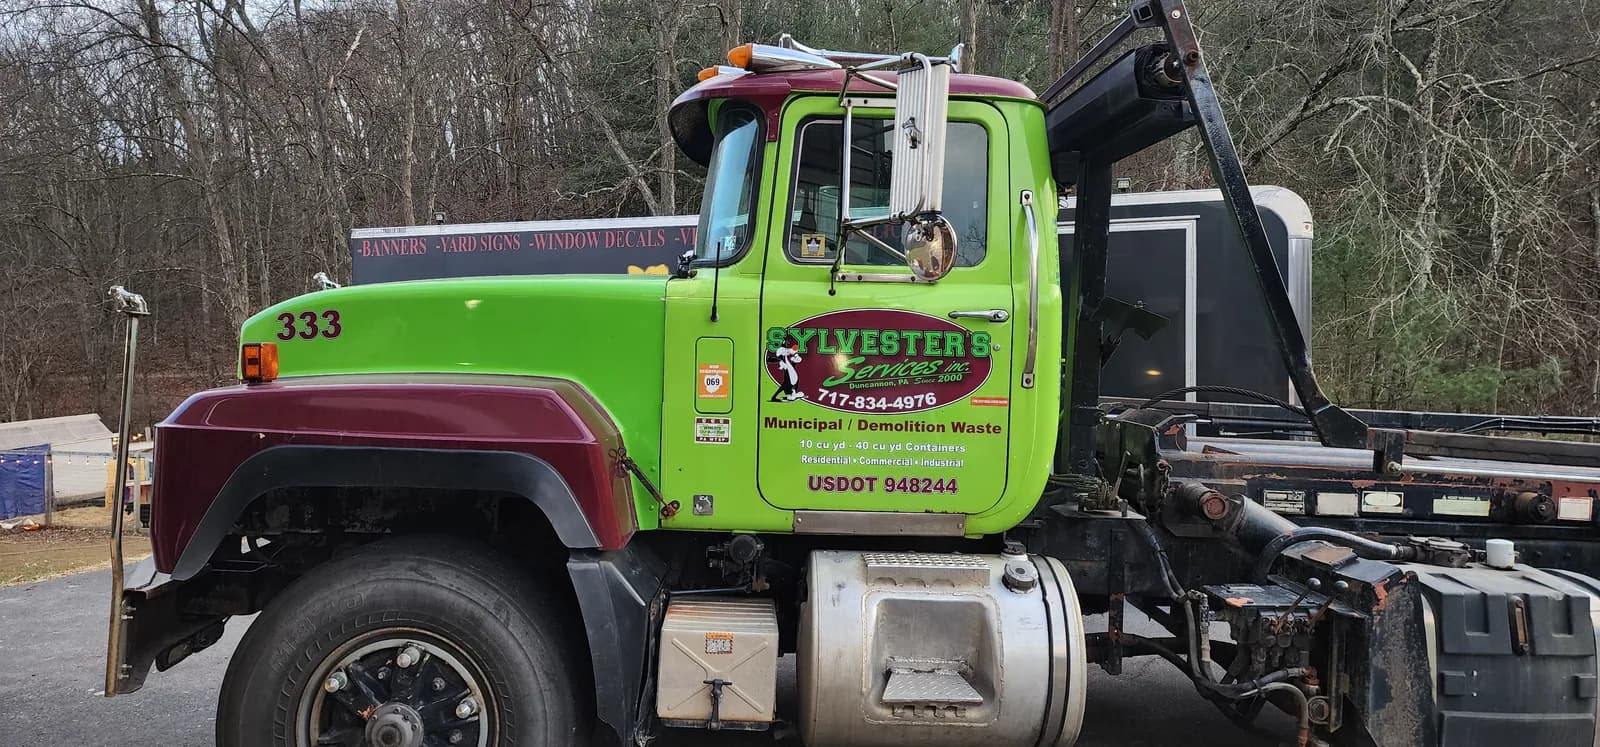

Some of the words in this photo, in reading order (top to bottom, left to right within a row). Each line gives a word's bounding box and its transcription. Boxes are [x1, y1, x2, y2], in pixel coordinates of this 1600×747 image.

[480, 233, 521, 251] SIGNS
[605, 229, 665, 249] DECALS
[276, 309, 342, 341] 333
[706, 377, 720, 386] 069
[823, 357, 943, 387] Services
[944, 360, 970, 373] inc.
[938, 373, 963, 383] 2000
[817, 388, 937, 411] 717-834-4976
[764, 417, 843, 434] Municipal
[847, 418, 853, 431] /
[857, 419, 946, 434] Demolition
[951, 421, 1002, 435] Waste
[800, 440, 813, 449] 10
[832, 440, 846, 451] yd
[855, 441, 869, 450] 40
[889, 442, 902, 452] yd
[905, 443, 967, 453] Containers
[801, 455, 851, 465] Residential
[859, 457, 913, 467] Commercial
[921, 458, 964, 468] Industrial
[808, 475, 878, 493] USDOT
[884, 477, 958, 495] 948244
